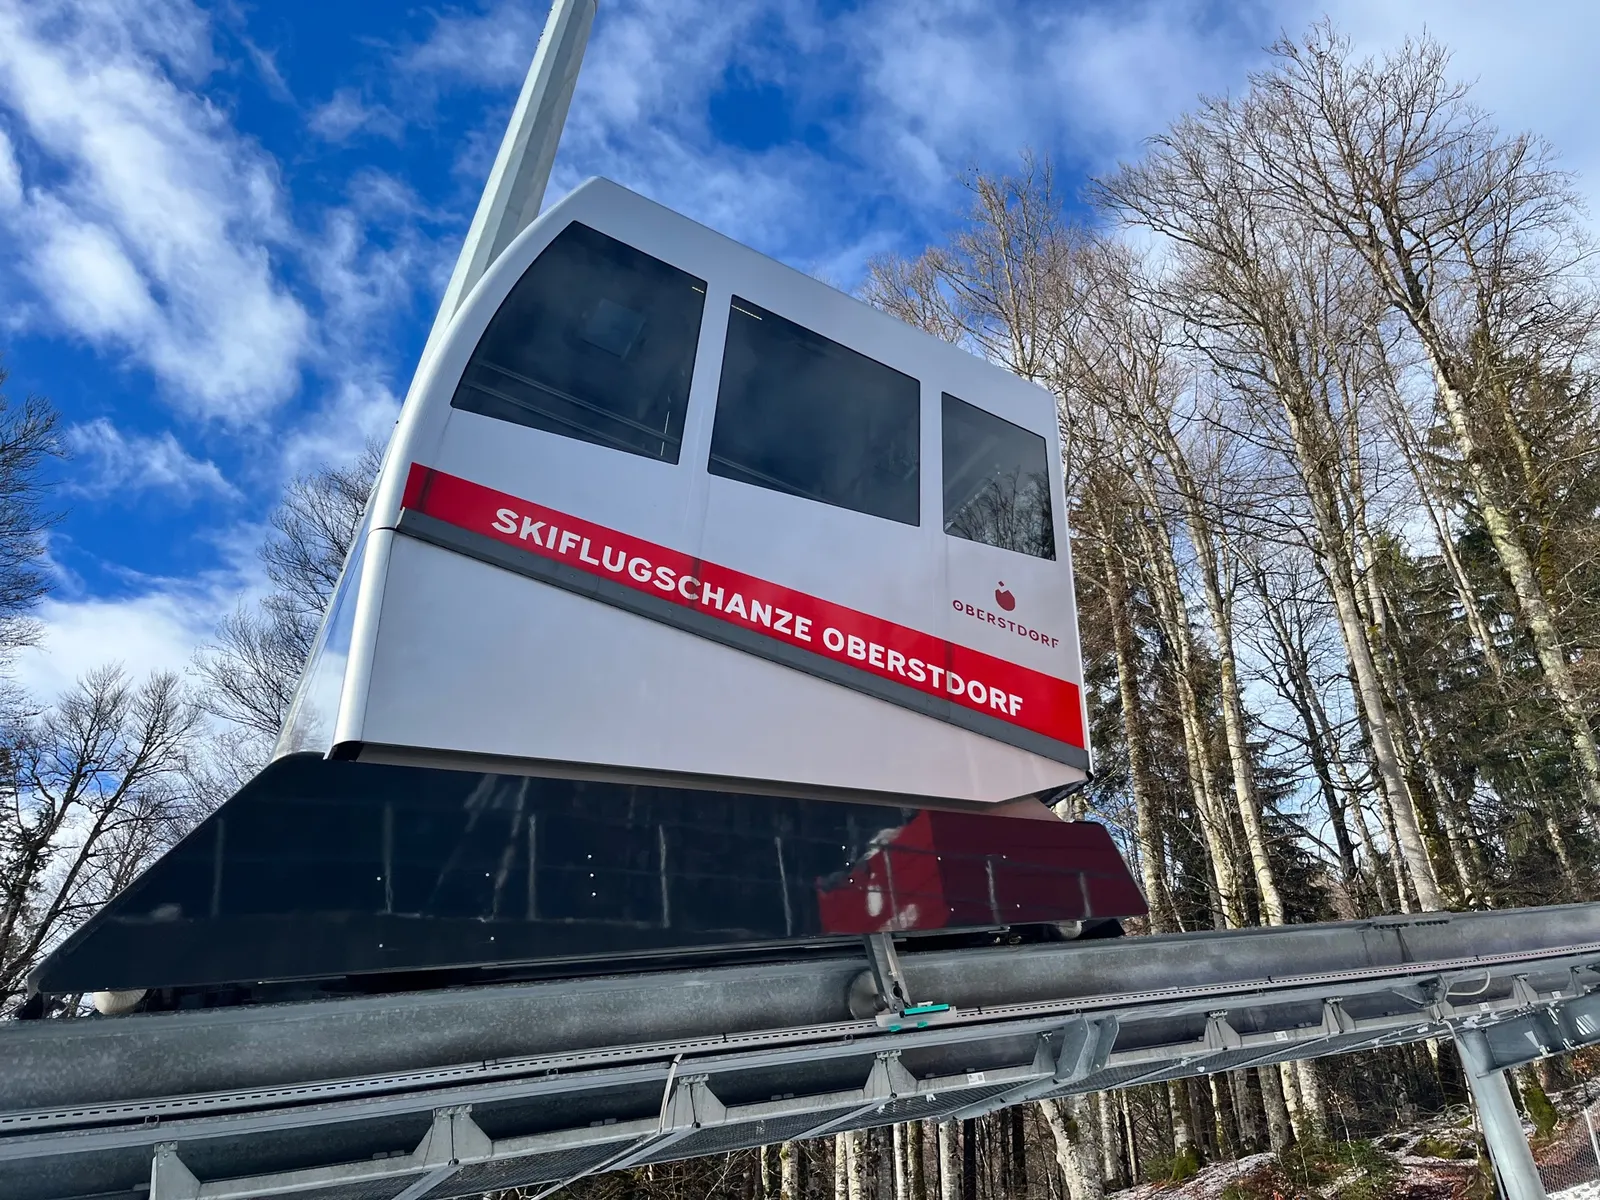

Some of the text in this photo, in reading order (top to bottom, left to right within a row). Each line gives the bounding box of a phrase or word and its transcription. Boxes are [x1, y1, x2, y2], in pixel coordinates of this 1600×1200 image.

[491, 507, 1024, 718] SKIFLUGSCHANZE OBERSTDORF
[952, 599, 1060, 649] OBERSTDORF
